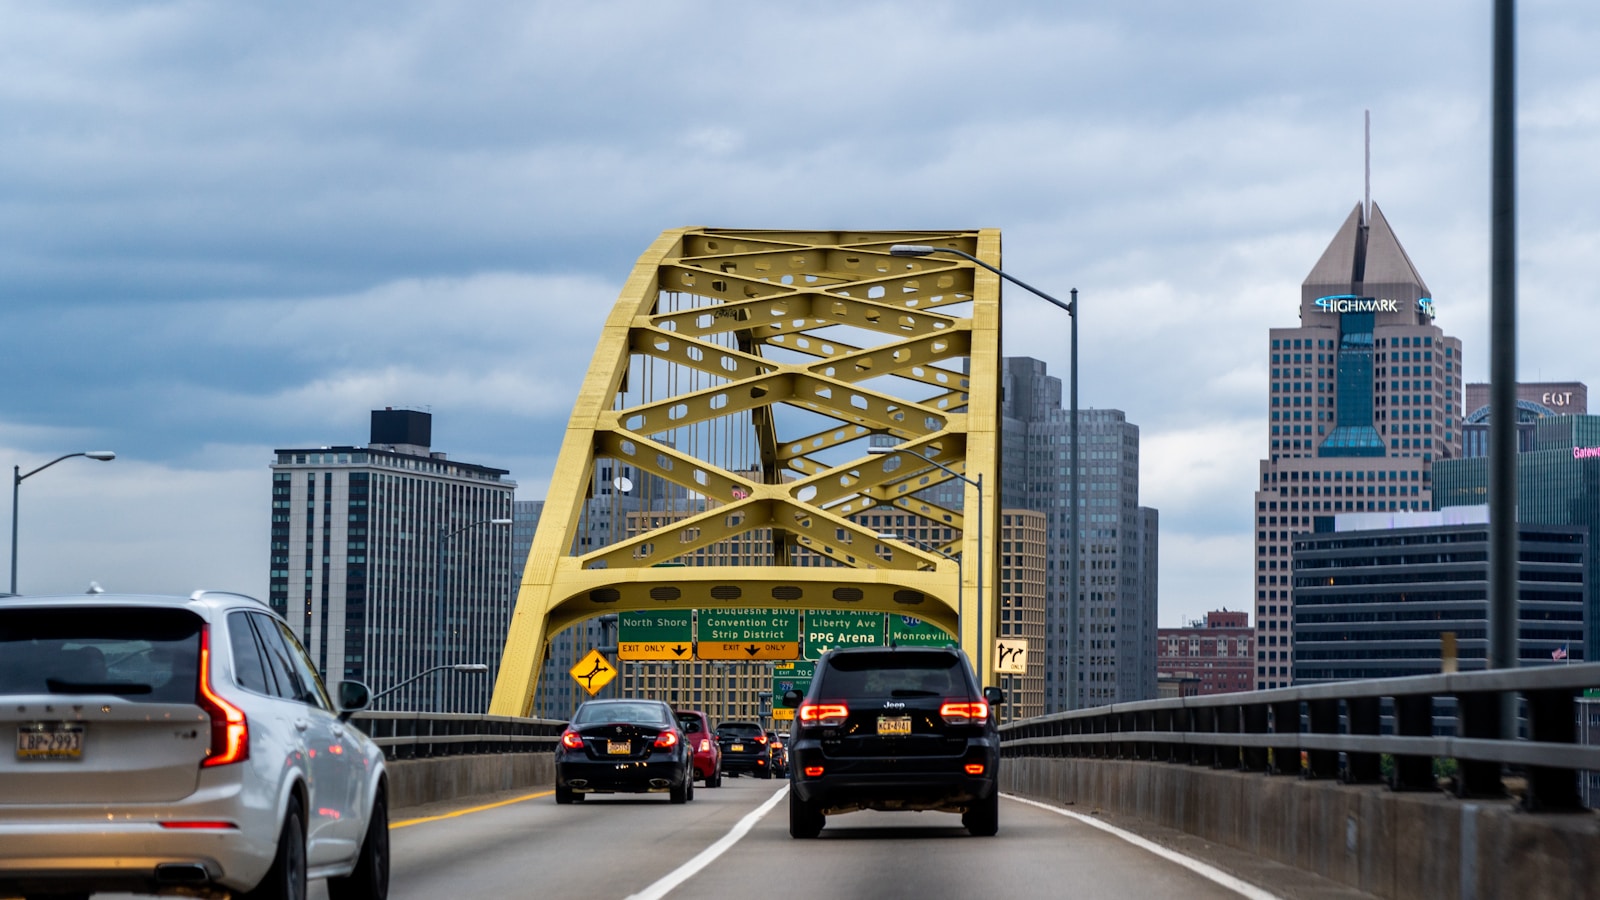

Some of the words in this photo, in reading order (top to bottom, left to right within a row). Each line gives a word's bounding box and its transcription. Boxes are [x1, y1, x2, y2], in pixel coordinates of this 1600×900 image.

[1323, 299, 1398, 313] HIGHMARK
[1542, 392, 1573, 406] EQT
[623, 618, 653, 627] North
[657, 618, 688, 627] Shore
[707, 618, 767, 627] Convention
[771, 618, 789, 627] Ctr
[812, 619, 851, 629] Liberty
[856, 619, 876, 628] Ave
[712, 630, 739, 640] Strip
[743, 630, 784, 639] District
[810, 632, 834, 643] PPG
[837, 632, 875, 643] Arena
[644, 644, 666, 652] ONLY
[883, 701, 906, 710] Jeep
